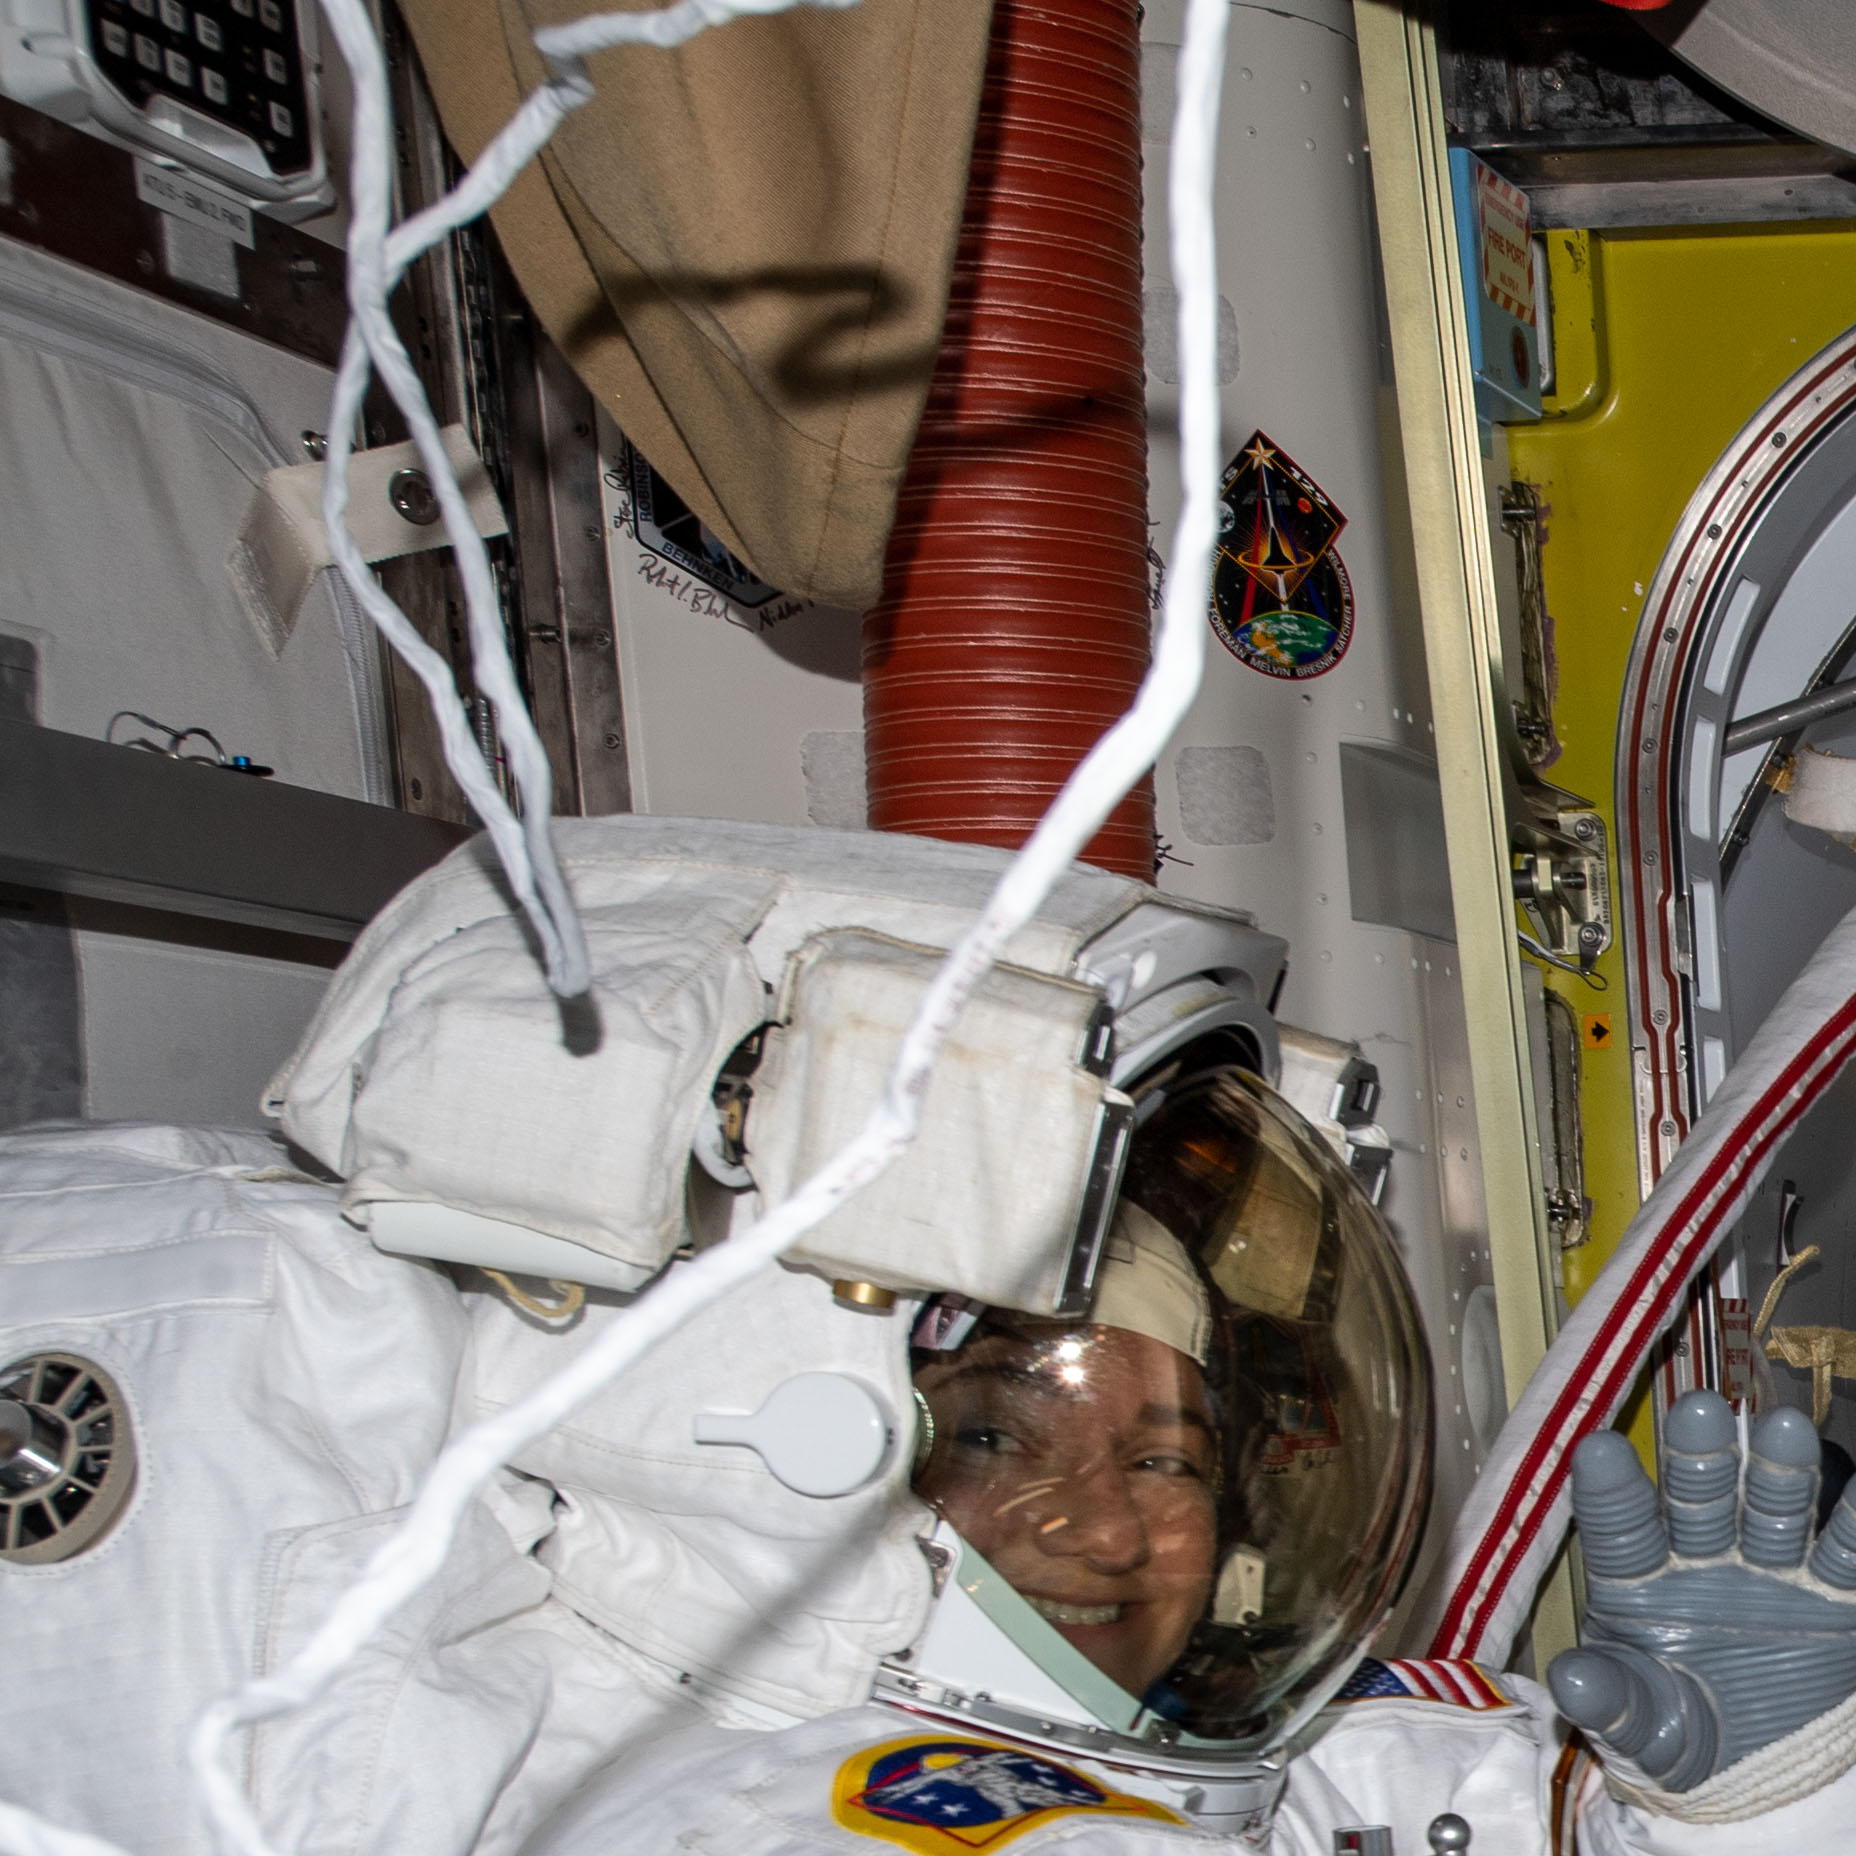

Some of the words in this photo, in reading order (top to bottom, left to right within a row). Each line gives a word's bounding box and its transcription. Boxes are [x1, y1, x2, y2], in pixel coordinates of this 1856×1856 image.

[1486, 226, 1505, 253] FIRE
[1506, 243, 1526, 271] PORT
[1288, 466, 1329, 506] 129
[661, 541, 735, 592] BEHNKEN
[1208, 607, 1247, 659] FOREMAN
[1250, 657, 1292, 677] MELVIN
